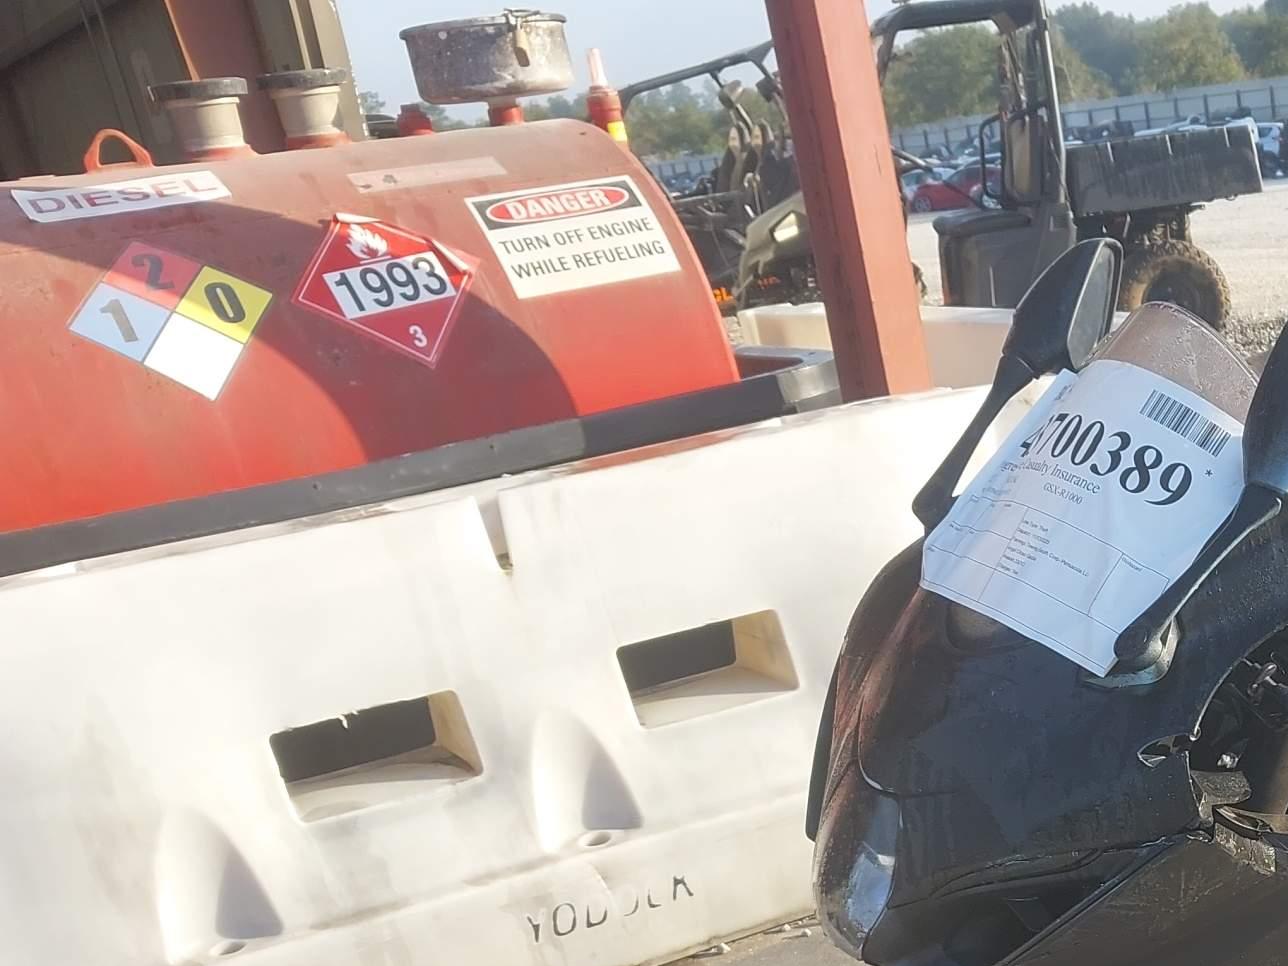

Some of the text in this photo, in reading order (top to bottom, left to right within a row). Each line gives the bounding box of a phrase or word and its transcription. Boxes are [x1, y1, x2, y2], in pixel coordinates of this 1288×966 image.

[28, 179, 218, 213] DIESEL
[504, 188, 612, 220] DANGER
[499, 217, 655, 255] TURN OFF ENGINE
[131, 253, 175, 290] 2
[511, 240, 666, 280] WHILE REFUELING
[204, 281, 247, 324] 0
[334, 256, 448, 312] 1993
[100, 298, 139, 343] 1
[408, 324, 428, 348] 3
[1050, 463, 1101, 494] Insurance
